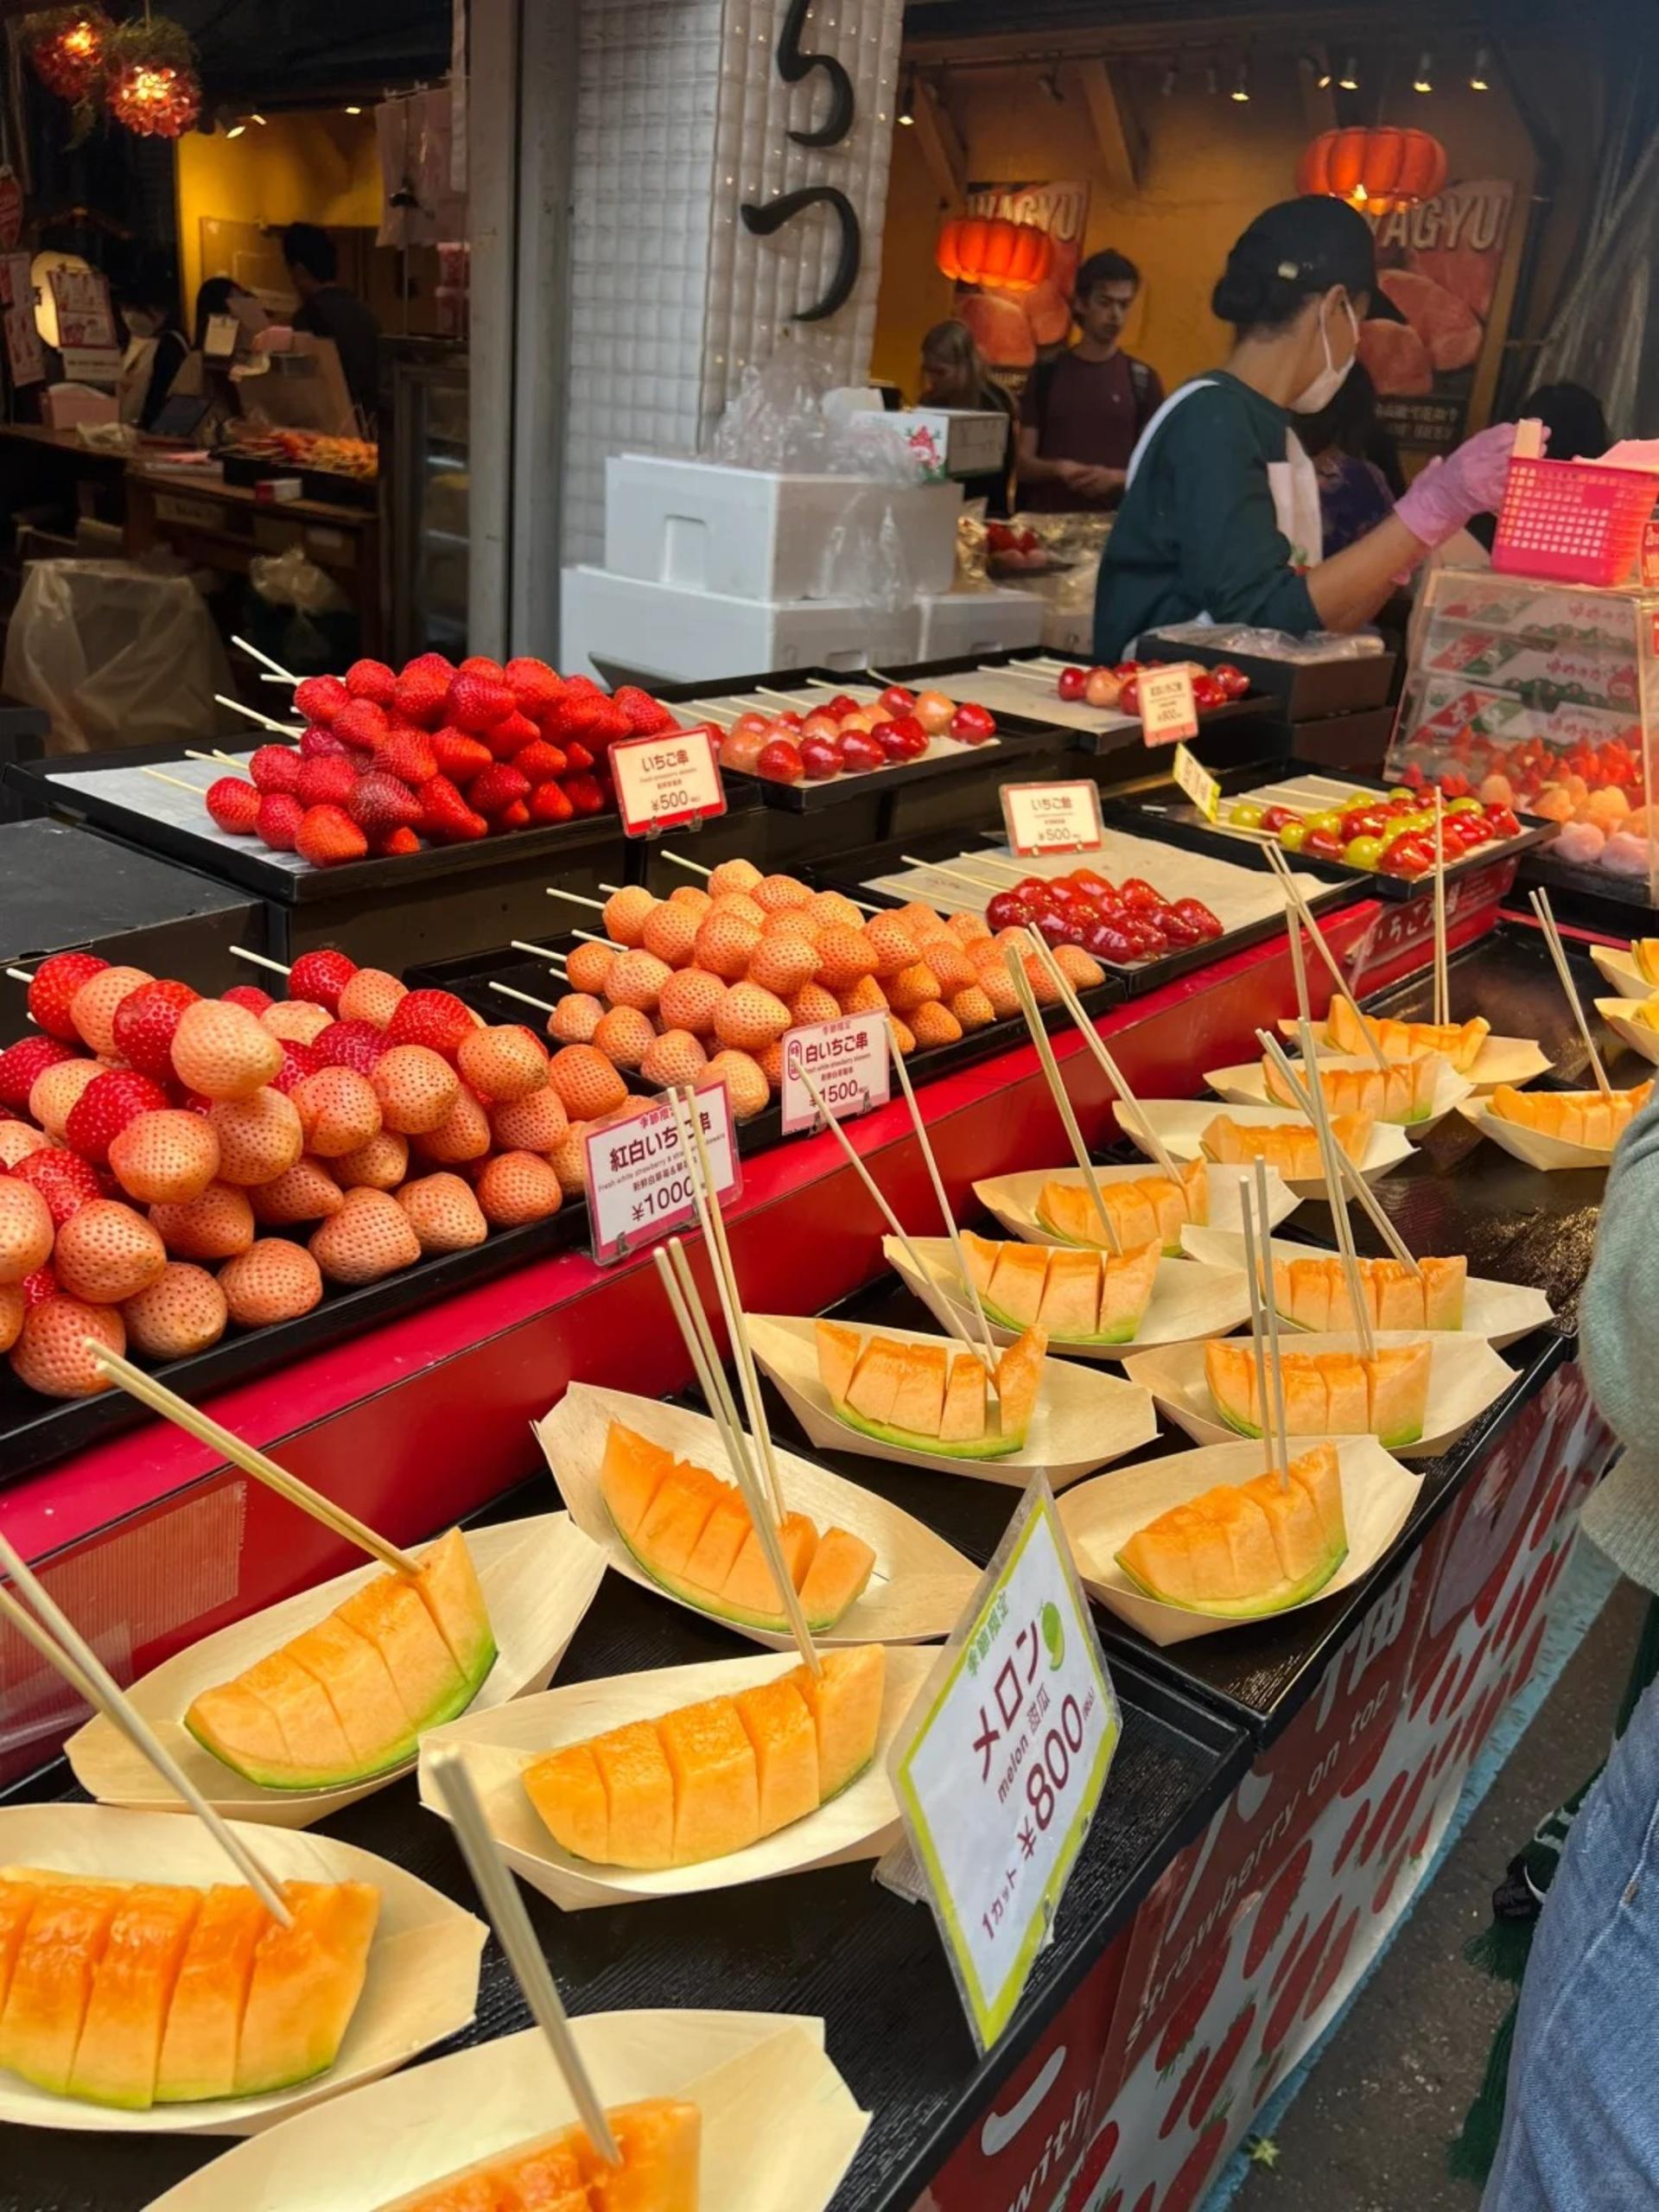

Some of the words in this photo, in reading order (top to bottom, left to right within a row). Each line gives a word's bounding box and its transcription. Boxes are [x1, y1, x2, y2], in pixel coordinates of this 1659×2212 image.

[1369, 192, 1507, 251] AGYU
[651, 790, 689, 812] ¥500
[805, 1031, 868, 1064] 白いちご串
[632, 1175, 695, 1223] ¥1000
[972, 1619, 1039, 1784] メロン
[997, 1734, 1029, 1804] melon
[1017, 1693, 1084, 1860] ¥800
[1125, 1788, 1301, 2057] strawberry
[1306, 1744, 1339, 1796] on
[1348, 1679, 1390, 1745] top
